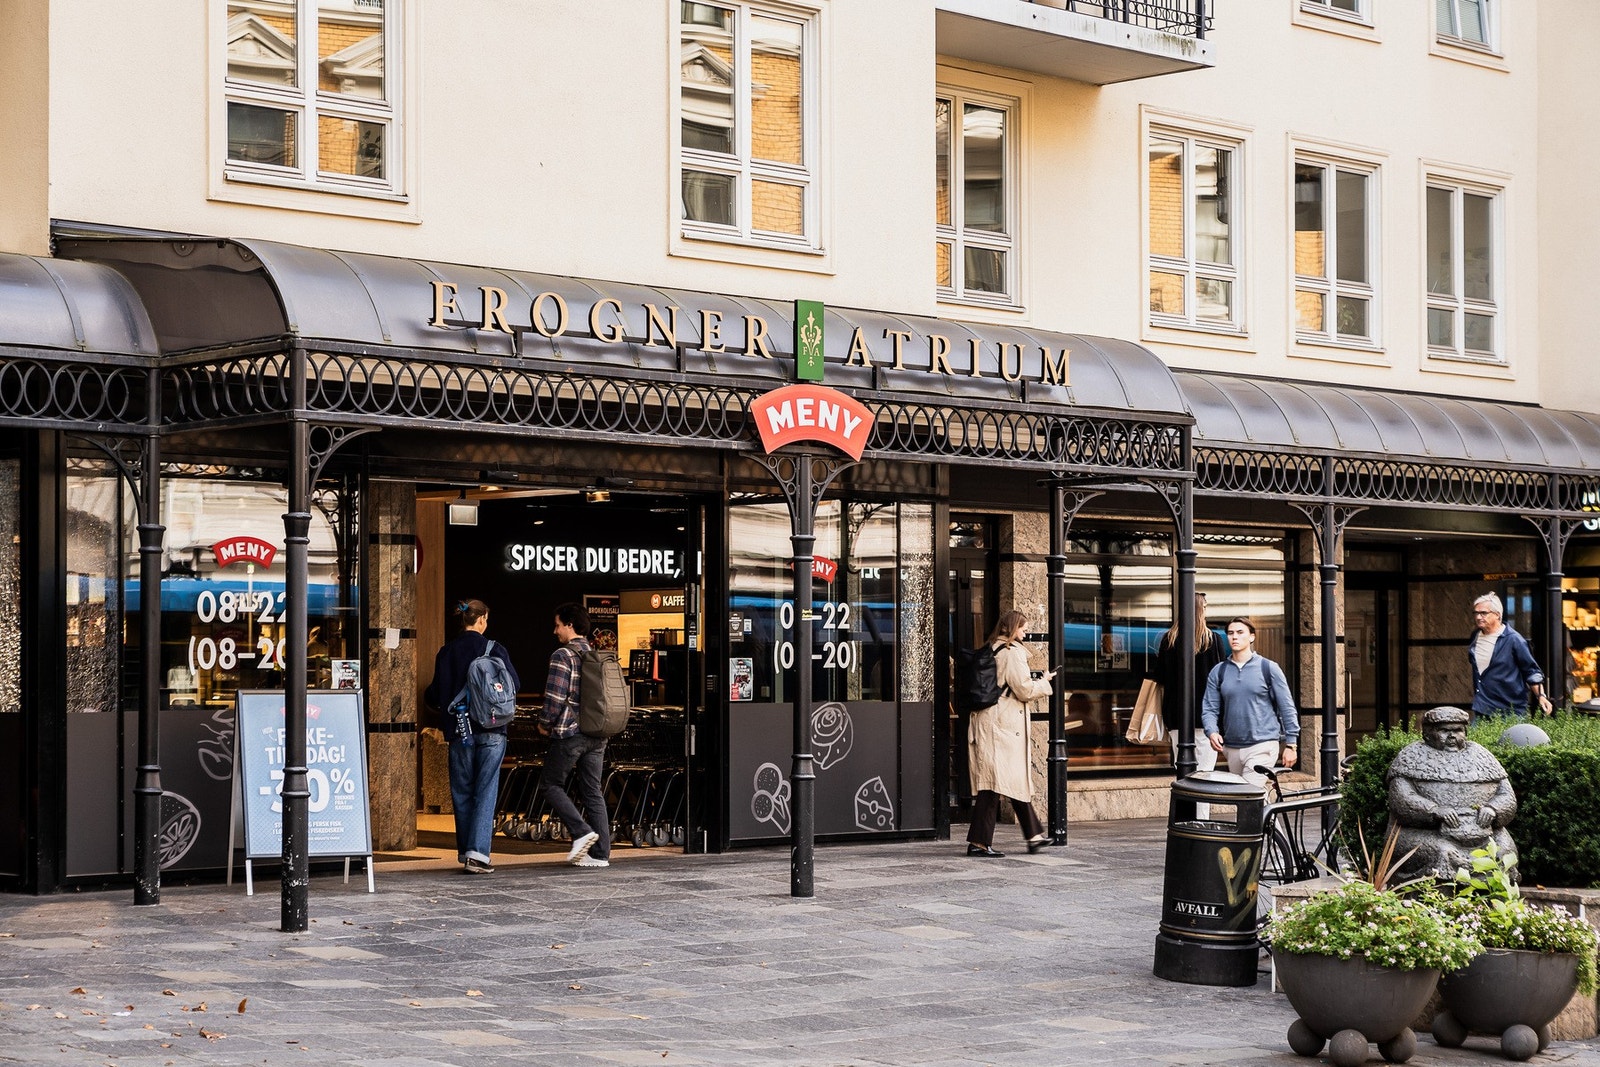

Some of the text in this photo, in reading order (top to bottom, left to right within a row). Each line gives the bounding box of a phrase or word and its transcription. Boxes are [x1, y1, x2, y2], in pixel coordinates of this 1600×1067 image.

[429, 280, 1073, 388] FROGNER ATRIUM
[765, 397, 863, 440] MENY
[219, 541, 271, 561] MENY
[510, 543, 579, 572] SPISER
[585, 547, 611, 574] DU
[617, 548, 681, 579] BEDRE,
[662, 595, 685, 607] KAFFE
[779, 601, 851, 631] 0–22
[773, 639, 858, 675] (0–20)
[1174, 901, 1219, 918] AVFALL
